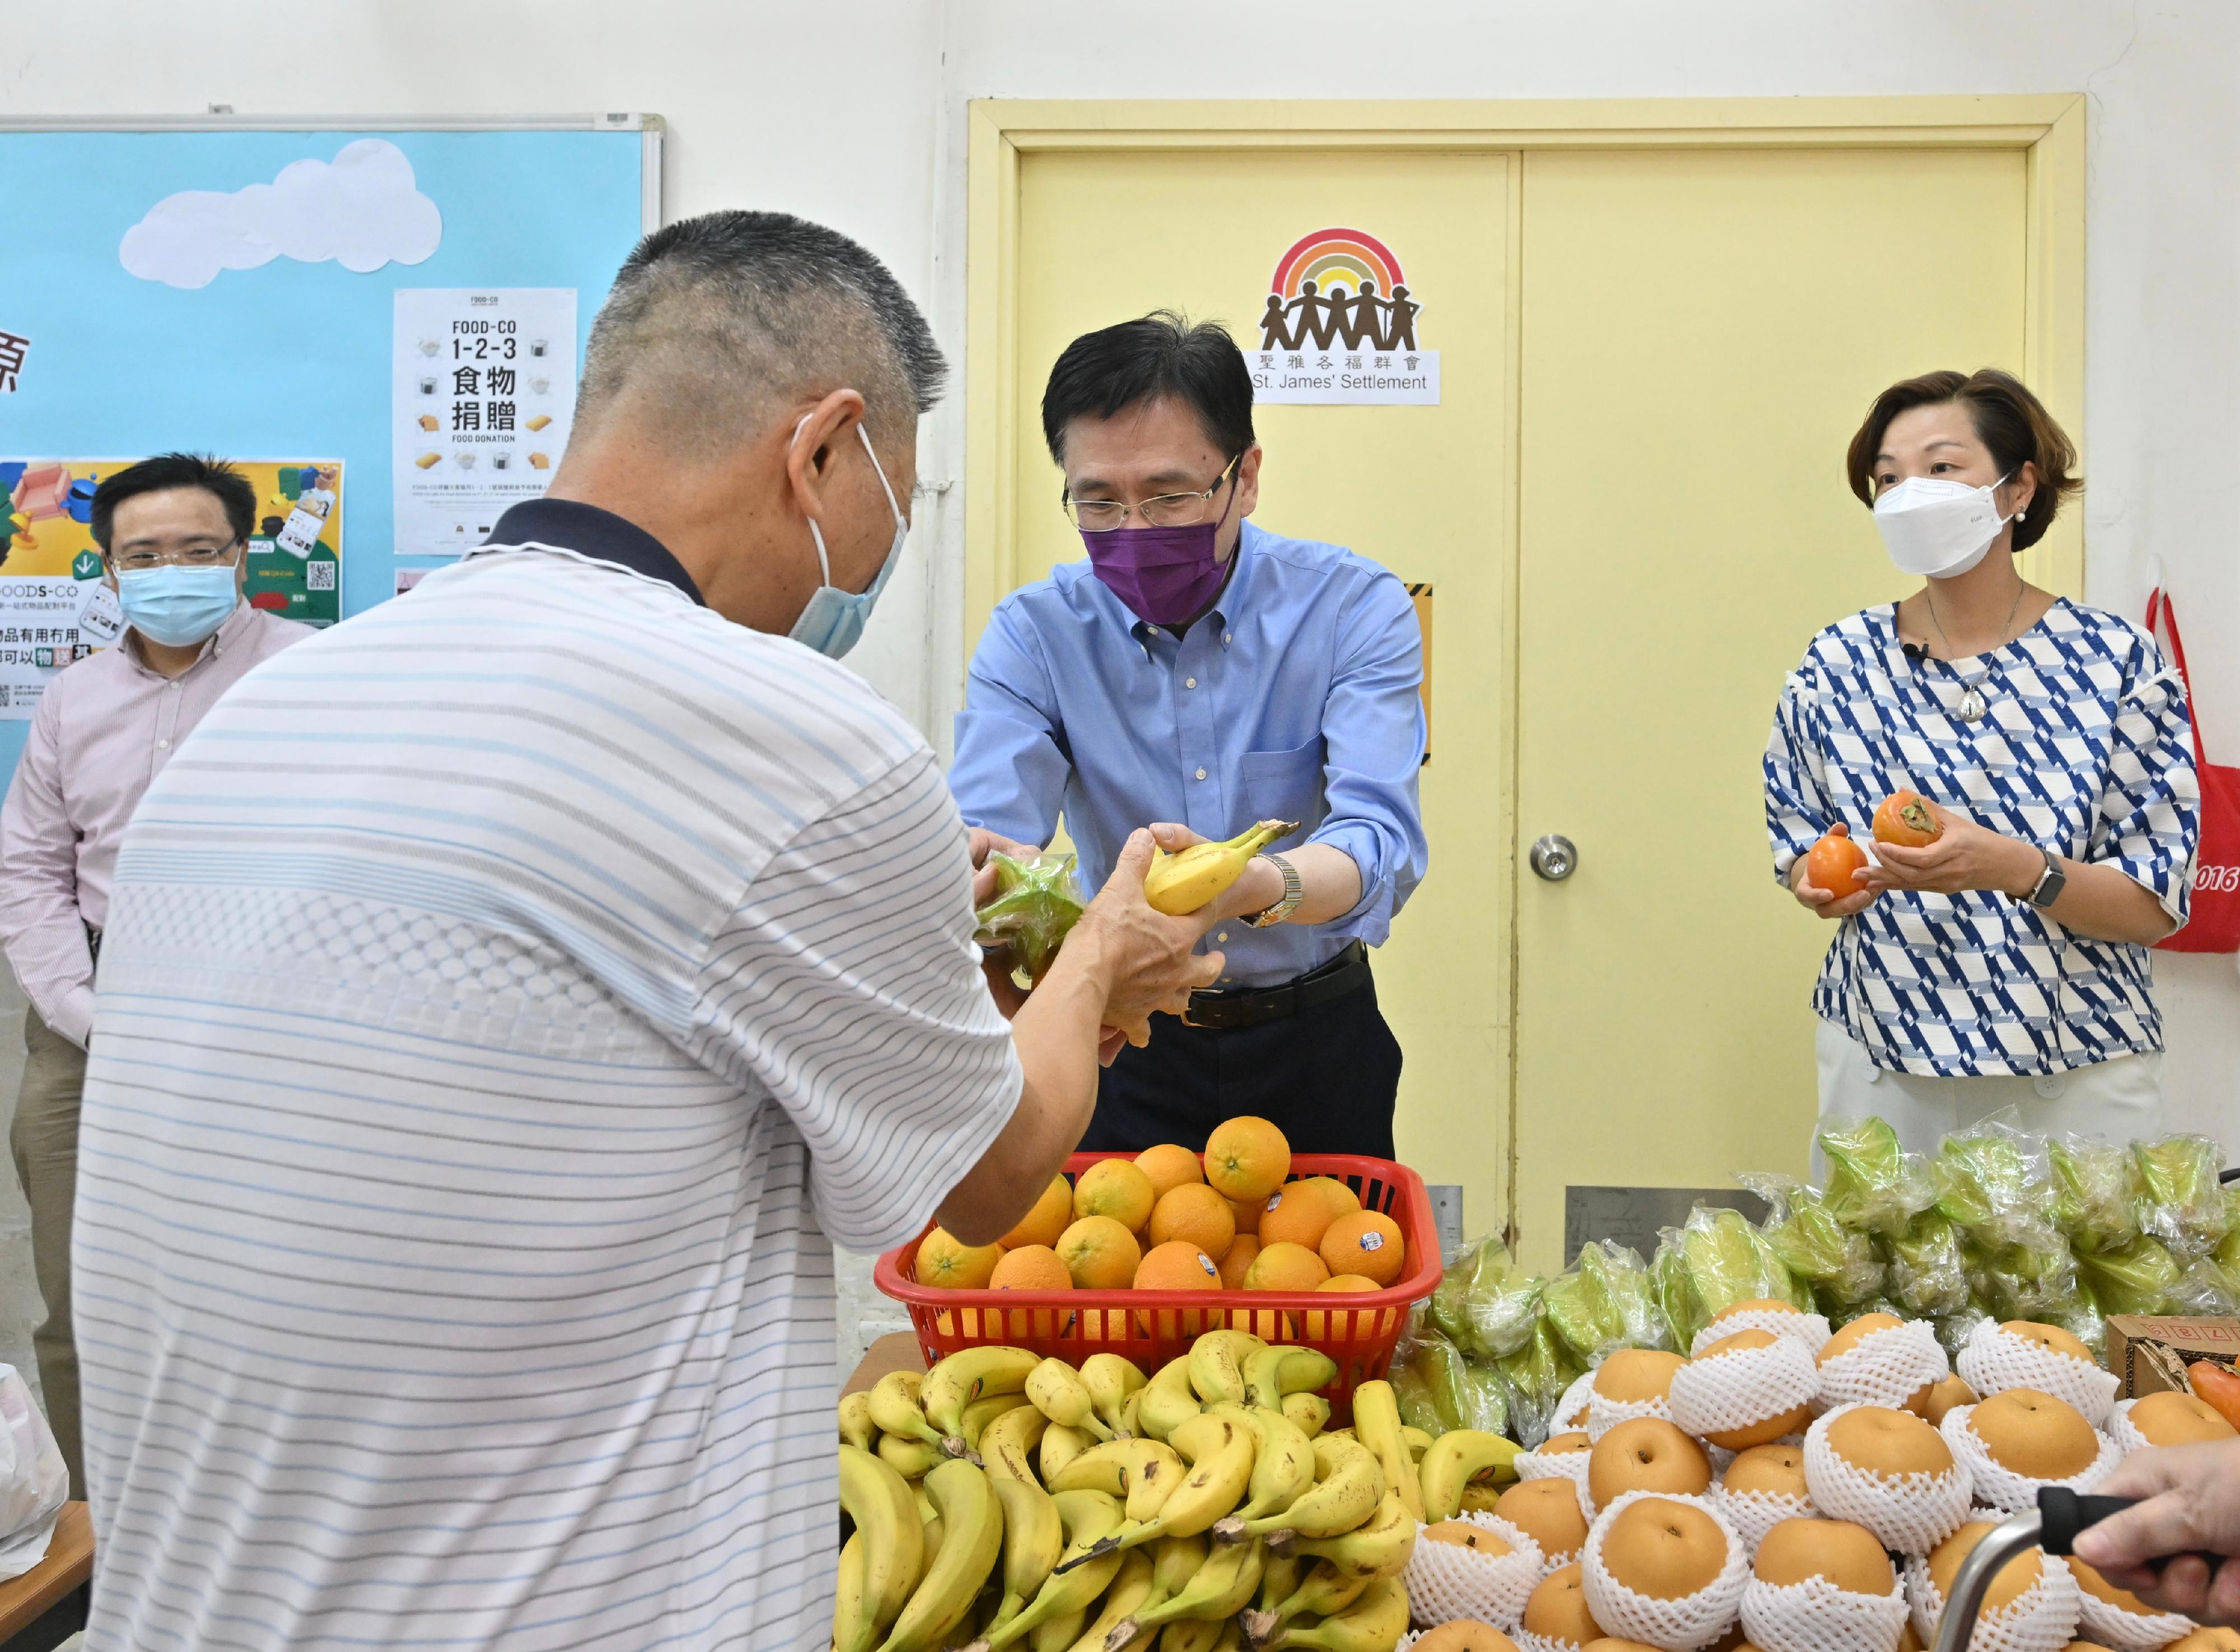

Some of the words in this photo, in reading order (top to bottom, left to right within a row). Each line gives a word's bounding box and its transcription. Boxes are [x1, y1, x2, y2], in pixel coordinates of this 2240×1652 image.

[452, 320, 516, 334] FOOD-CO
[452, 338, 516, 359] 1-2-3
[1258, 354, 1421, 371] 聖雅各福群會
[452, 366, 516, 395] 食物
[1253, 374, 1273, 389] St.
[1279, 374, 1335, 389] James'
[1341, 374, 1427, 389] Settlement
[452, 400, 516, 431] 捐贈
[0, 586, 78, 598] OODS-CO
[0, 628, 79, 643] 品有用冇用
[2192, 865, 2240, 893] 016
